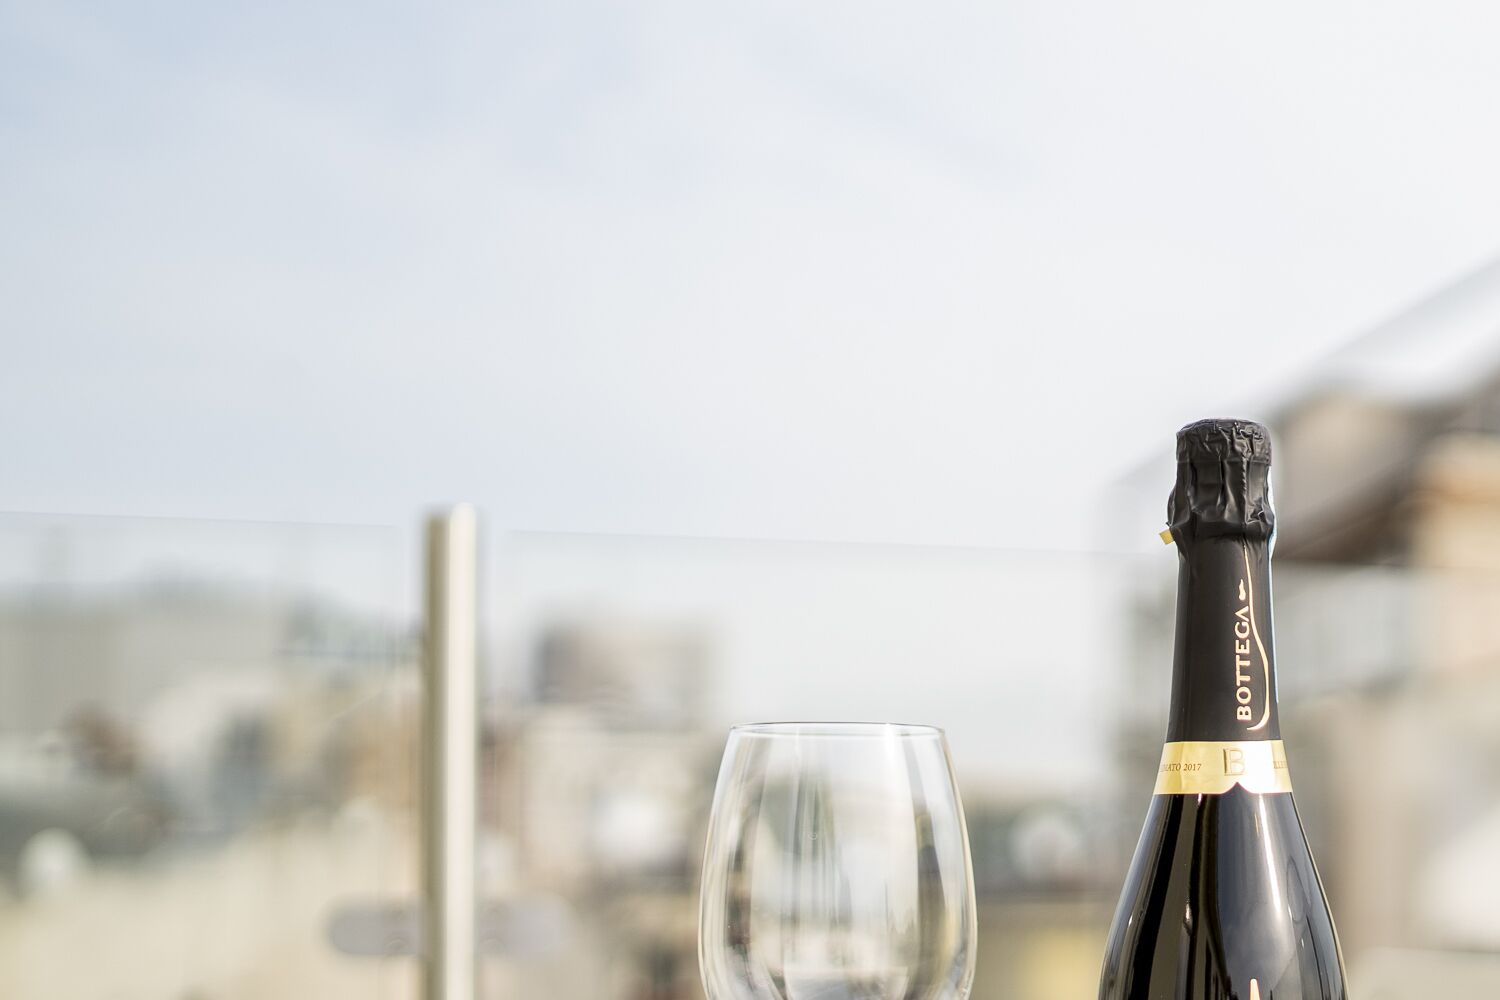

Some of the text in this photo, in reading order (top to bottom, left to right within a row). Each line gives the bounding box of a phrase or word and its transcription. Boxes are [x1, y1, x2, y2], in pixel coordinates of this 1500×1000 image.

[1235, 606, 1252, 721] BOTTEGA
[1183, 763, 1202, 772] 2017
[1222, 748, 1246, 776] B
